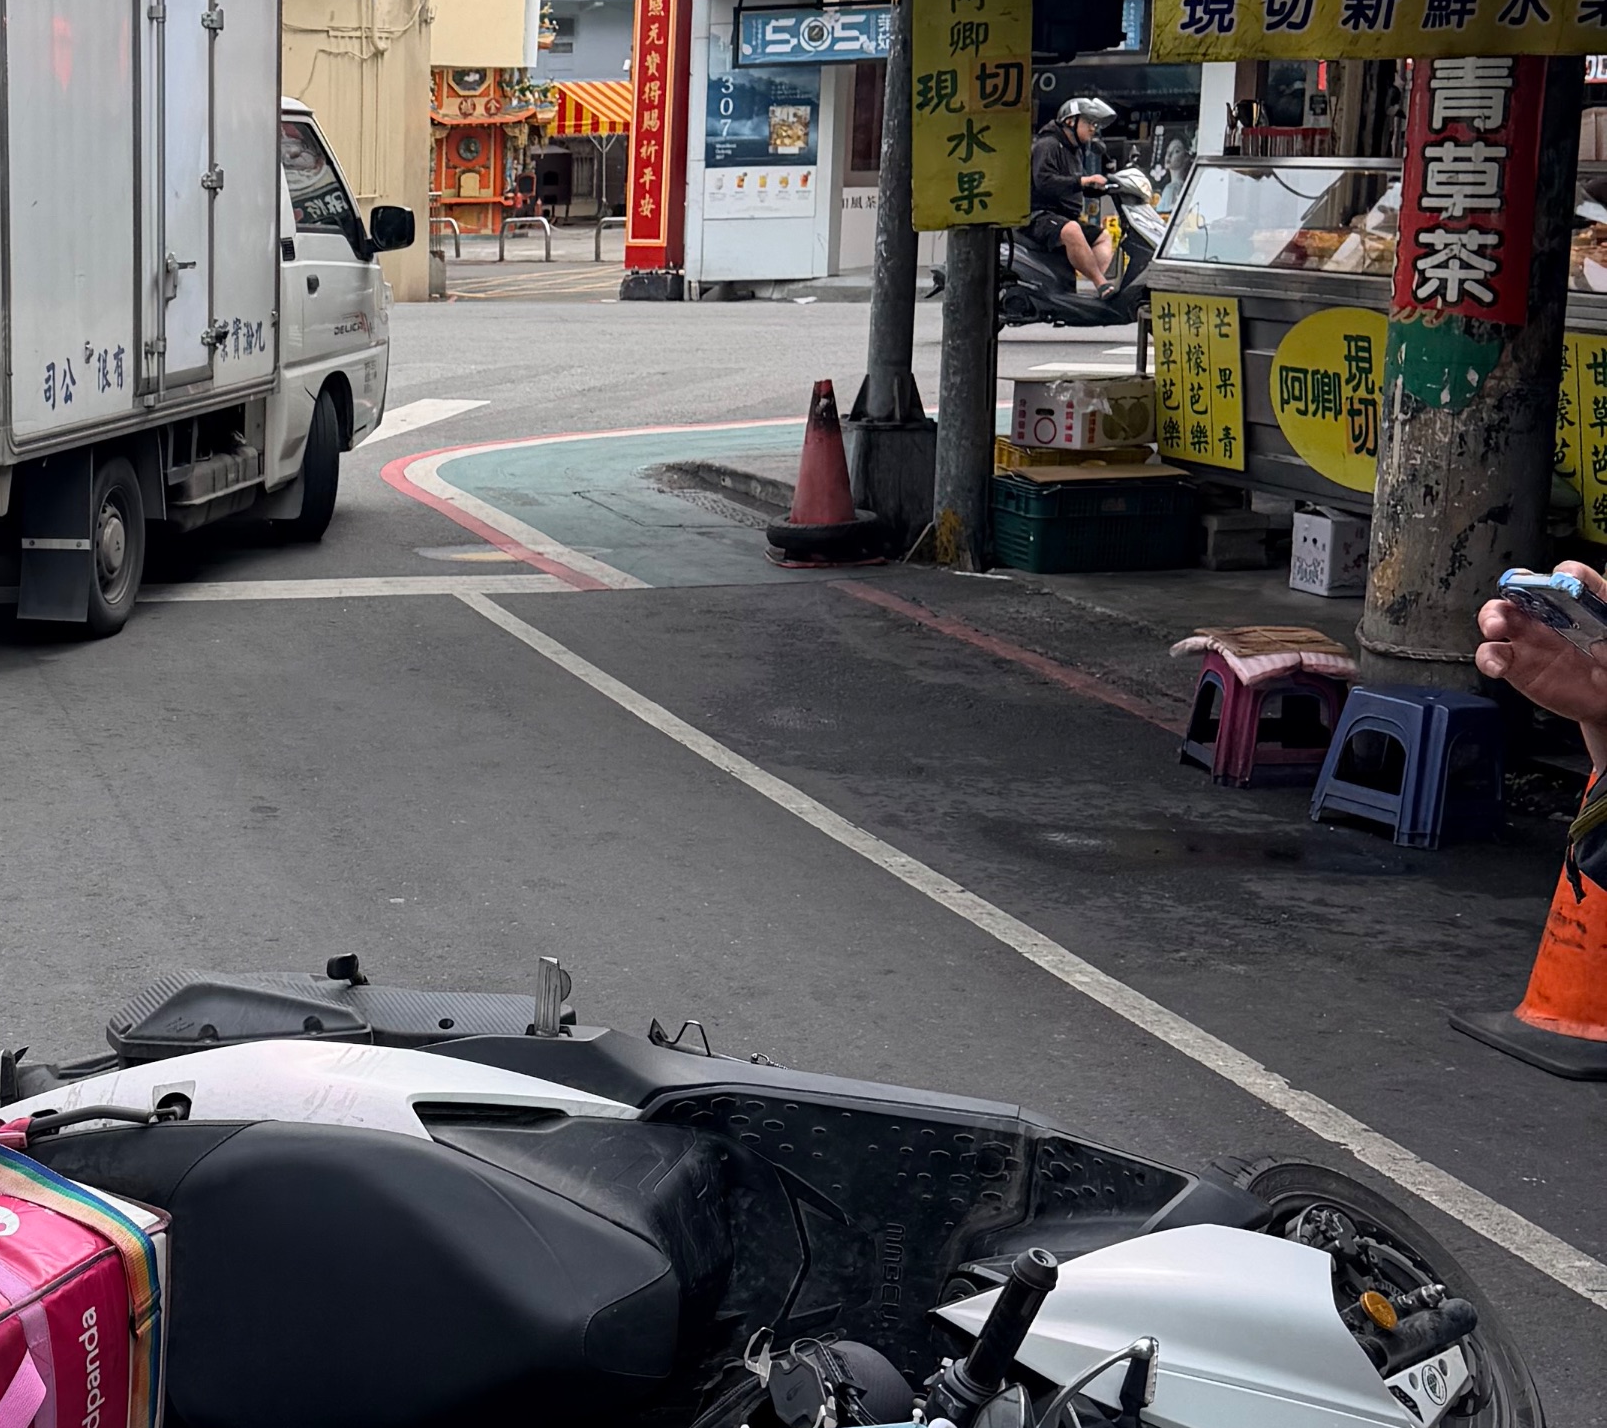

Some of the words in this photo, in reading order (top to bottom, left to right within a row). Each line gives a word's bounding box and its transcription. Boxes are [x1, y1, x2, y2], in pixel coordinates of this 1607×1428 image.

[946, 117, 997, 216] 水果
[1416, 56, 1514, 307] 青草茶
[1157, 301, 1182, 449] 甘草芭樂
[1184, 302, 1210, 455] 檸檬芭樂
[1213, 307, 1238, 461] 芒果青
[1278, 364, 1343, 422] 阿卿
